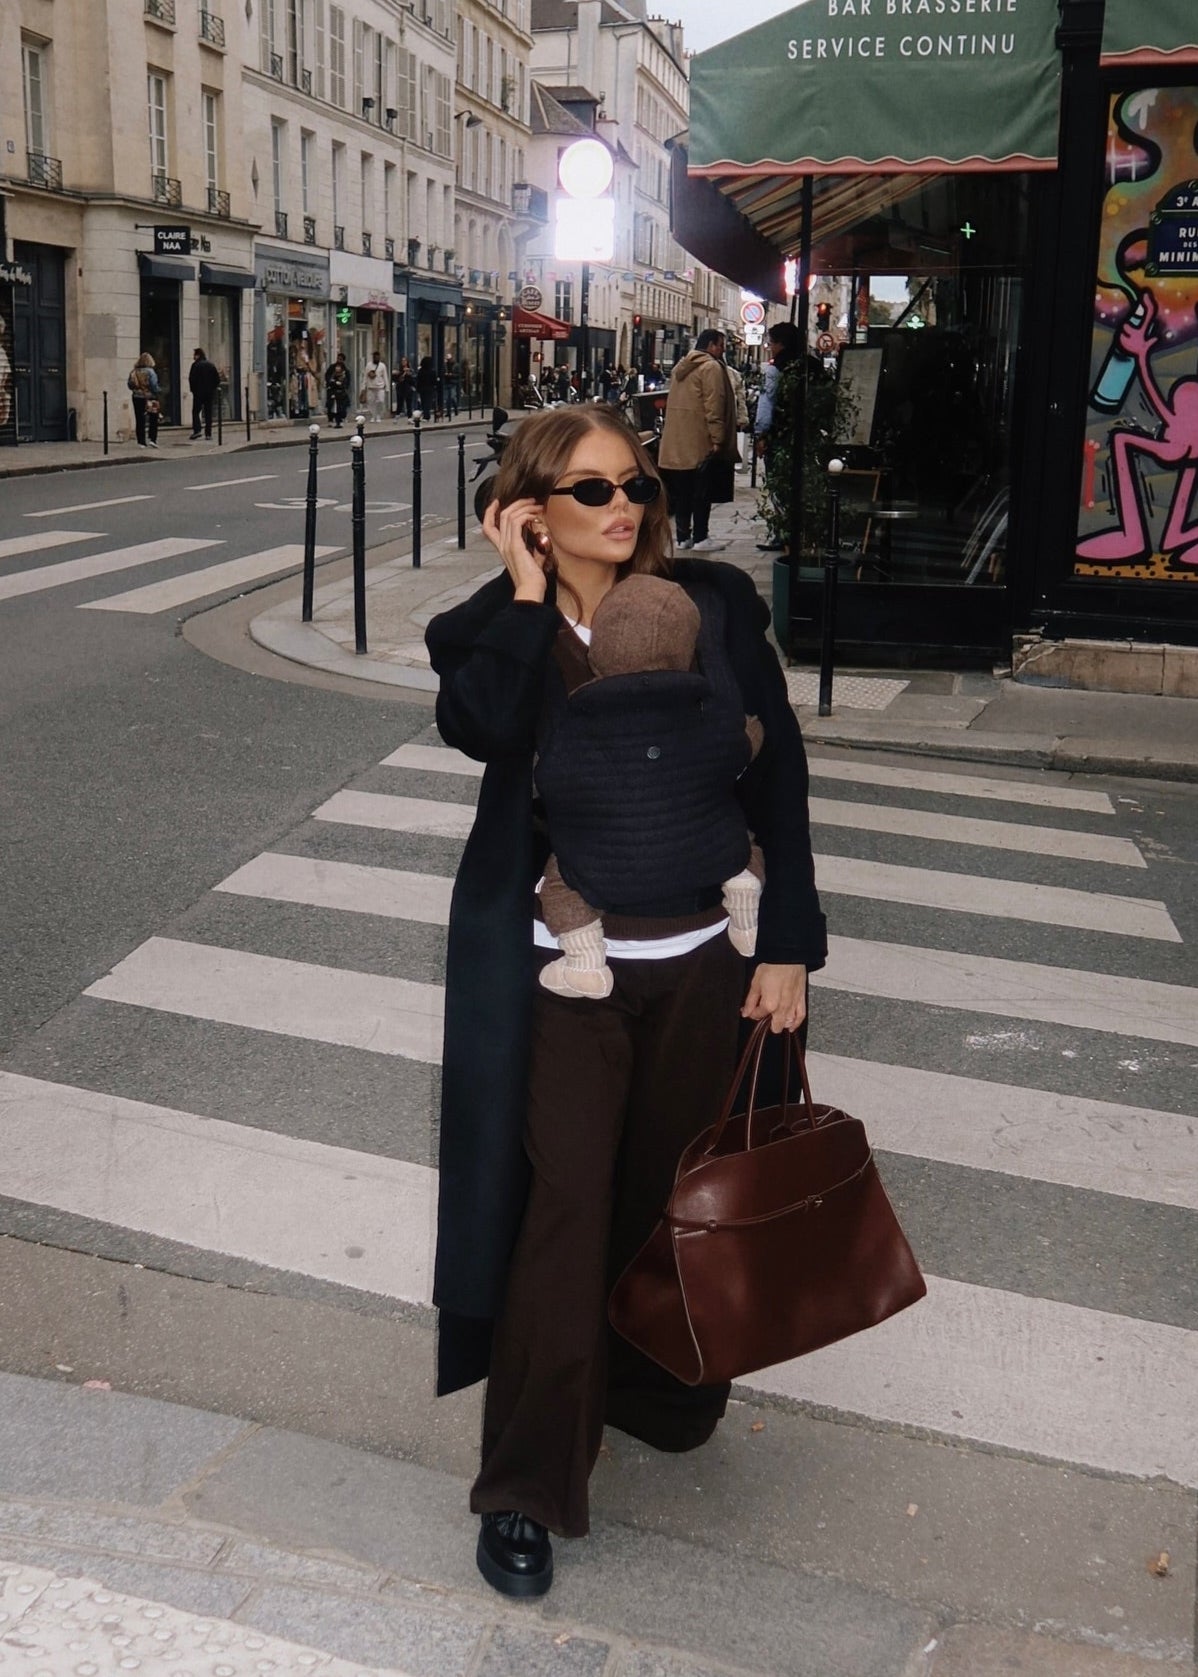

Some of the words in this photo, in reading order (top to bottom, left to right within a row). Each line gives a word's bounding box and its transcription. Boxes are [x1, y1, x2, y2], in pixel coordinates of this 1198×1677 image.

[828, 0, 871, 16] BAR
[886, 0, 1017, 14] BRASSERIE
[787, 37, 886, 59] SERVICE
[899, 34, 1015, 56] CONTINU
[157, 231, 187, 240] CLAIRE
[1179, 227, 1198, 238] RU
[162, 241, 182, 250] NAA
